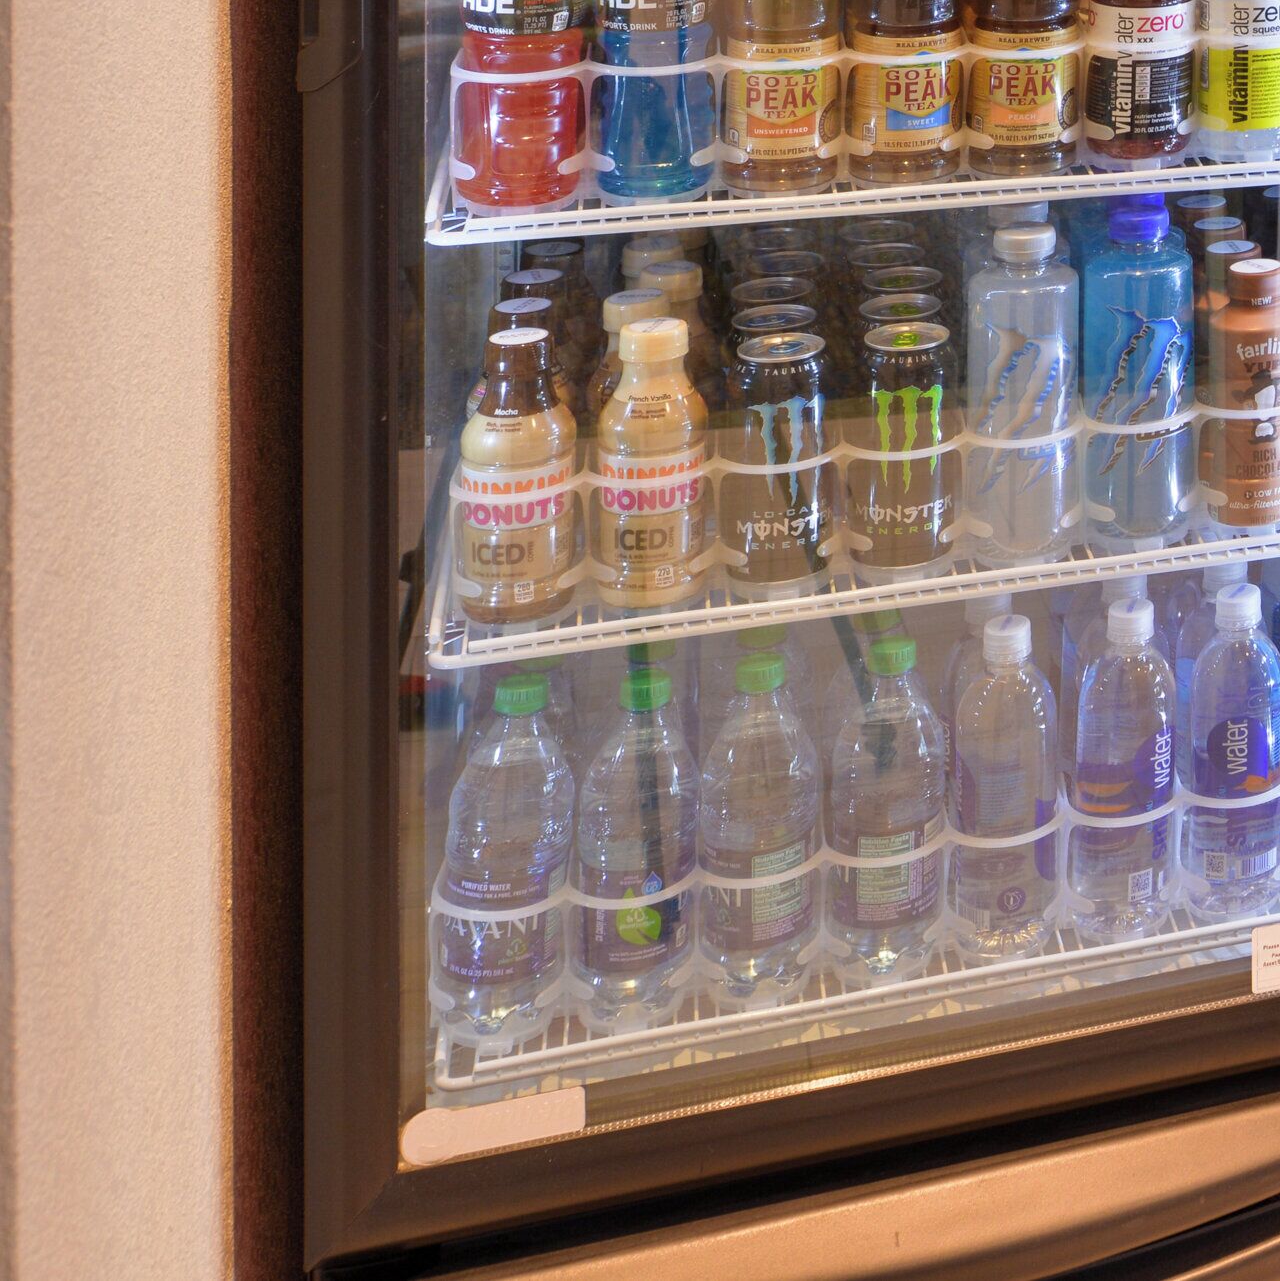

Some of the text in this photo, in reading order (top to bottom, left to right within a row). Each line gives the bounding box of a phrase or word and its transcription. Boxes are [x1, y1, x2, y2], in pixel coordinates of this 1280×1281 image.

[465, 22, 515, 36] SPORTS DRINK
[629, 22, 657, 31] DRINK
[1137, 15, 1185, 33] zero
[885, 67, 953, 82] GOLD
[988, 63, 1057, 75] GOLD
[746, 73, 818, 88] GOLD
[988, 74, 1057, 98] PEAK
[884, 76, 953, 103] PEAK
[746, 85, 818, 112] PEAK
[1004, 97, 1038, 106] TEA
[904, 101, 936, 112] TEA
[763, 110, 798, 120] TEA
[907, 117, 935, 127] SWEET
[753, 126, 809, 136] UNSWEETENED
[1251, 296, 1272, 307] NEW!
[882, 353, 935, 364] TAURINE
[763, 361, 818, 377] TAURINE
[650, 393, 672, 401] Vanilla
[494, 408, 518, 416] Mocha
[1252, 448, 1277, 461] RICH
[602, 478, 700, 512] DONUTS
[1254, 488, 1272, 498] LOW
[462, 492, 566, 526] DONUTS
[855, 494, 953, 525] MONSTER
[614, 527, 668, 551] ICED
[472, 541, 526, 566] ICED
[461, 880, 512, 891] PURIFIED WATER
